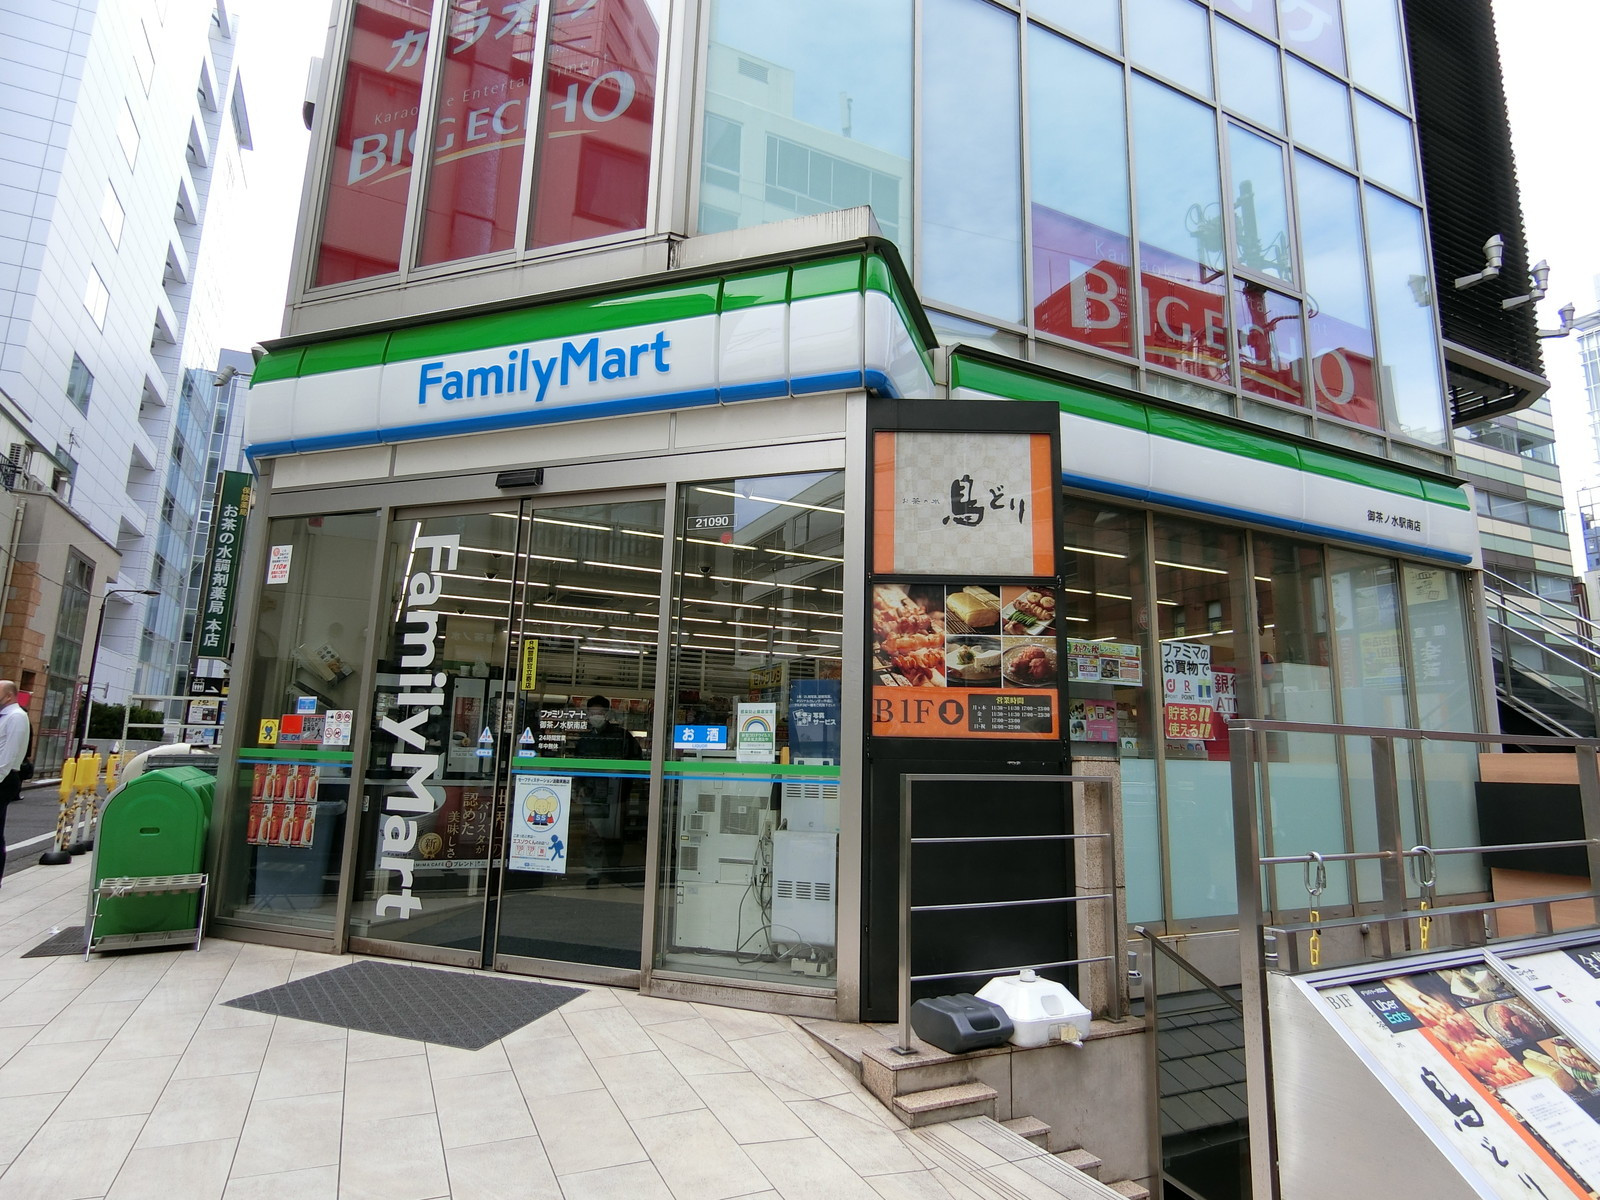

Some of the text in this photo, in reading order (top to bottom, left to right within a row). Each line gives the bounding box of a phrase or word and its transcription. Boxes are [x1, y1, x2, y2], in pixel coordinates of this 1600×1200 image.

[386, 0, 602, 72] カラオ
[374, 94, 455, 126] Karaoe
[1069, 258, 1192, 343] BIG
[418, 330, 672, 405] FamilyMart
[695, 515, 729, 528] 21090
[1367, 509, 1421, 532] 御茶ノ水駅南店
[203, 503, 239, 648] お茶の水調剤薬局 本店
[1162, 643, 1209, 661] ファミマの
[1164, 659, 1210, 677] お買物で
[873, 698, 935, 725] B1F
[996, 696, 1025, 705] 営業時間
[376, 533, 459, 920] FamilyMart
[540, 720, 588, 730] 御茶ノ水駅南店
[541, 709, 587, 719] ファミリーマート
[461, 792, 480, 836] 認めた
[446, 810, 461, 859] 美味しさ
[1371, 999, 1399, 1012] Uber
[1383, 1011, 1412, 1025] Eats
